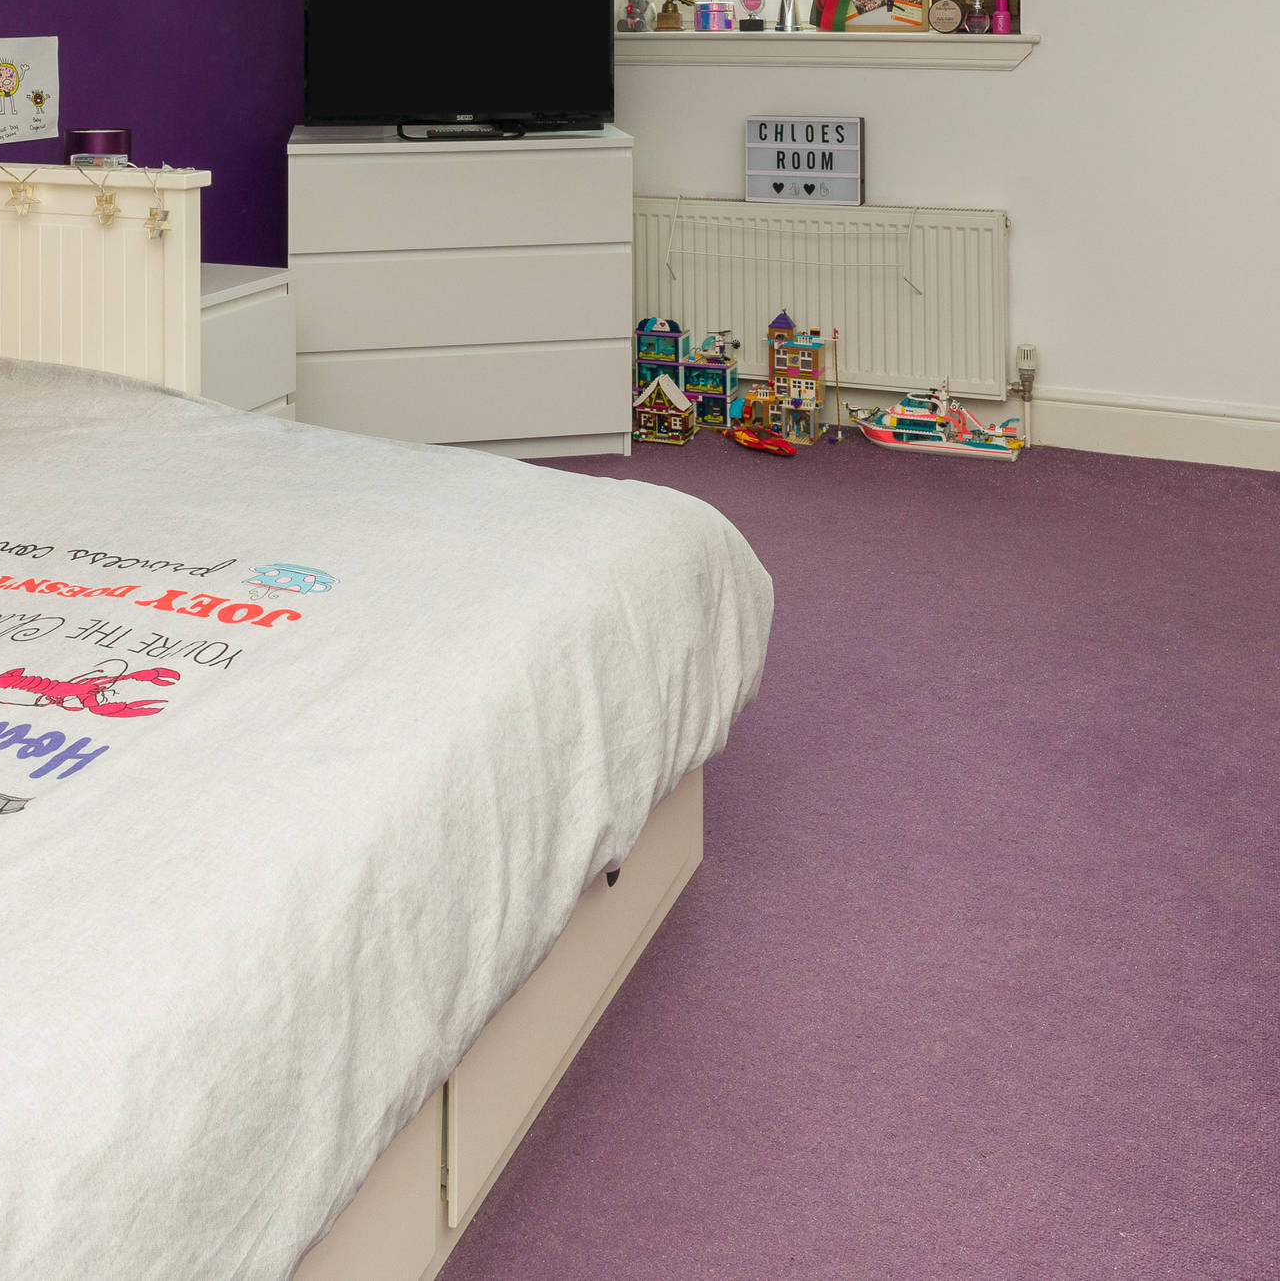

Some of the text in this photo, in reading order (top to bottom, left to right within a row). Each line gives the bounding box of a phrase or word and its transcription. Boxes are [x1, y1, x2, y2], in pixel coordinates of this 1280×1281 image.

[777, 151, 833, 170] ROOM
[67, 548, 237, 577] princess
[135, 589, 302, 628] JOEY
[65, 619, 133, 649] THE
[129, 633, 242, 669] YOU'RE
